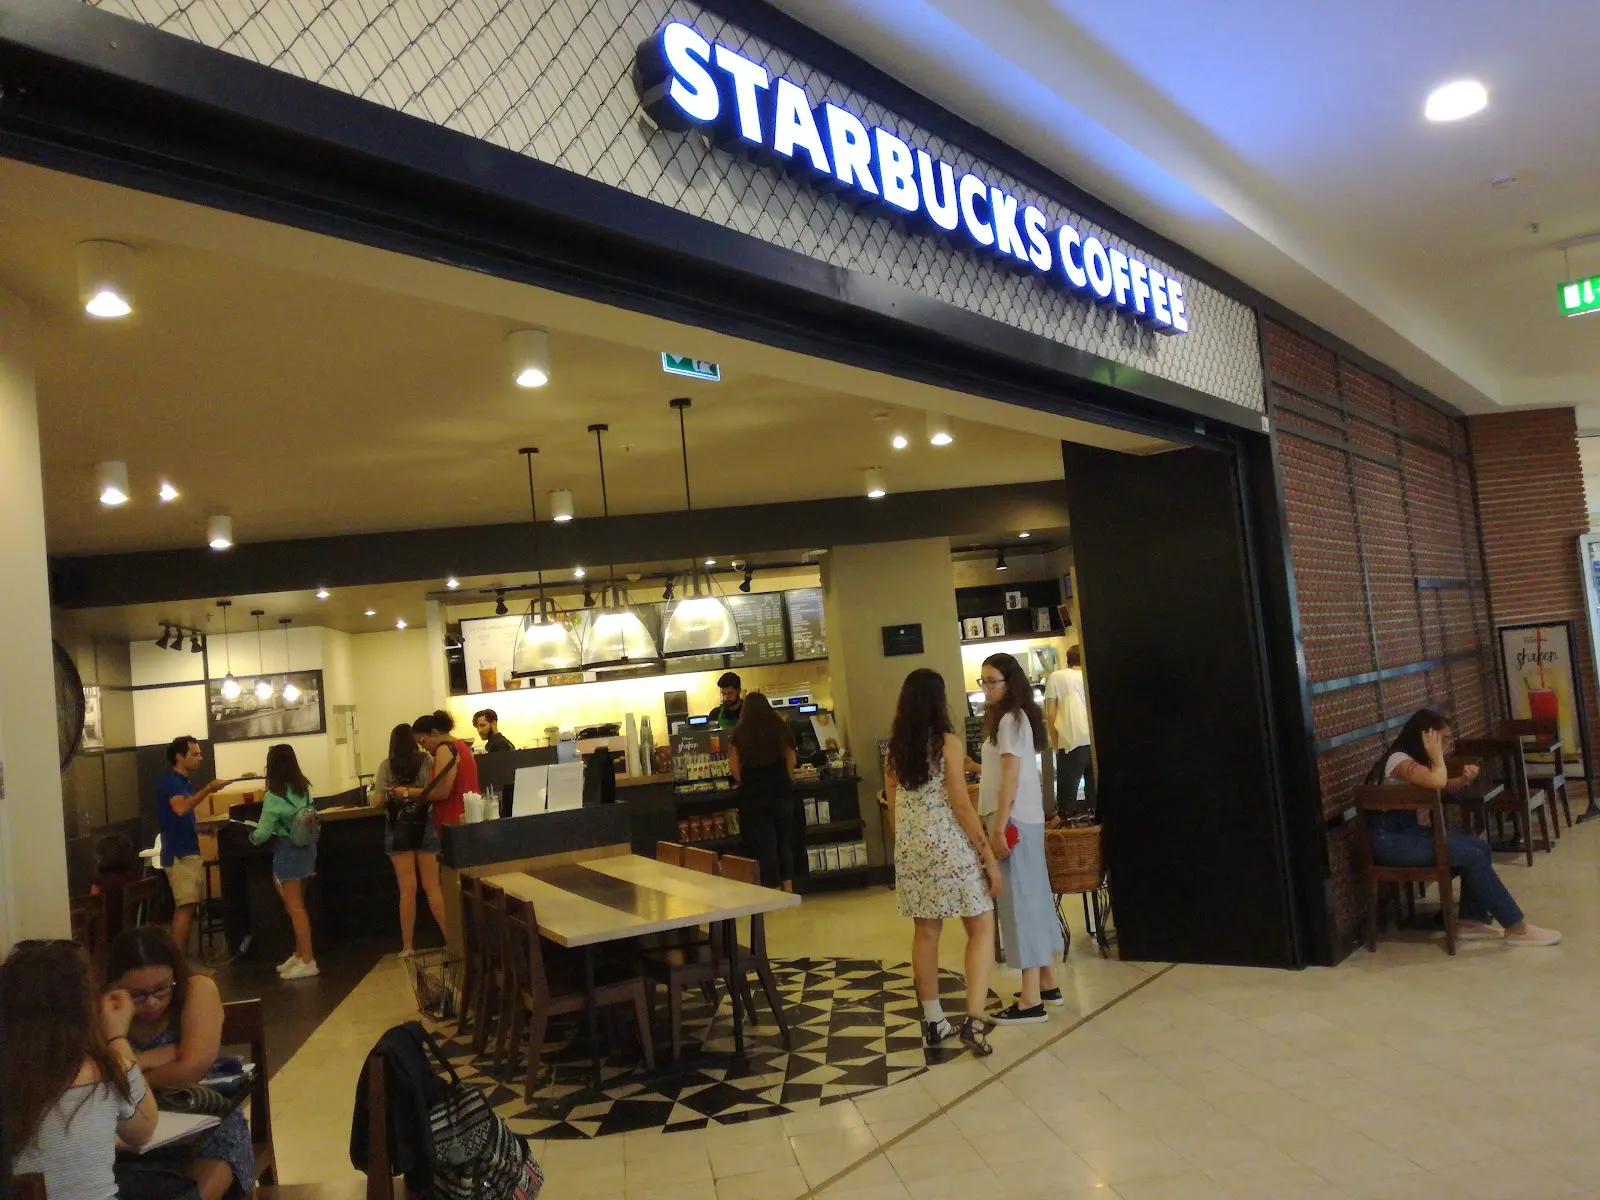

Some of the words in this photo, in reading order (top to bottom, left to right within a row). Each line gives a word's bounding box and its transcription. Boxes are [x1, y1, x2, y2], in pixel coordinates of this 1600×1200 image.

[663, 22, 1052, 272] STARBUCKS
[1058, 224, 1189, 333] COFFEE
[1515, 647, 1559, 671] shaken
